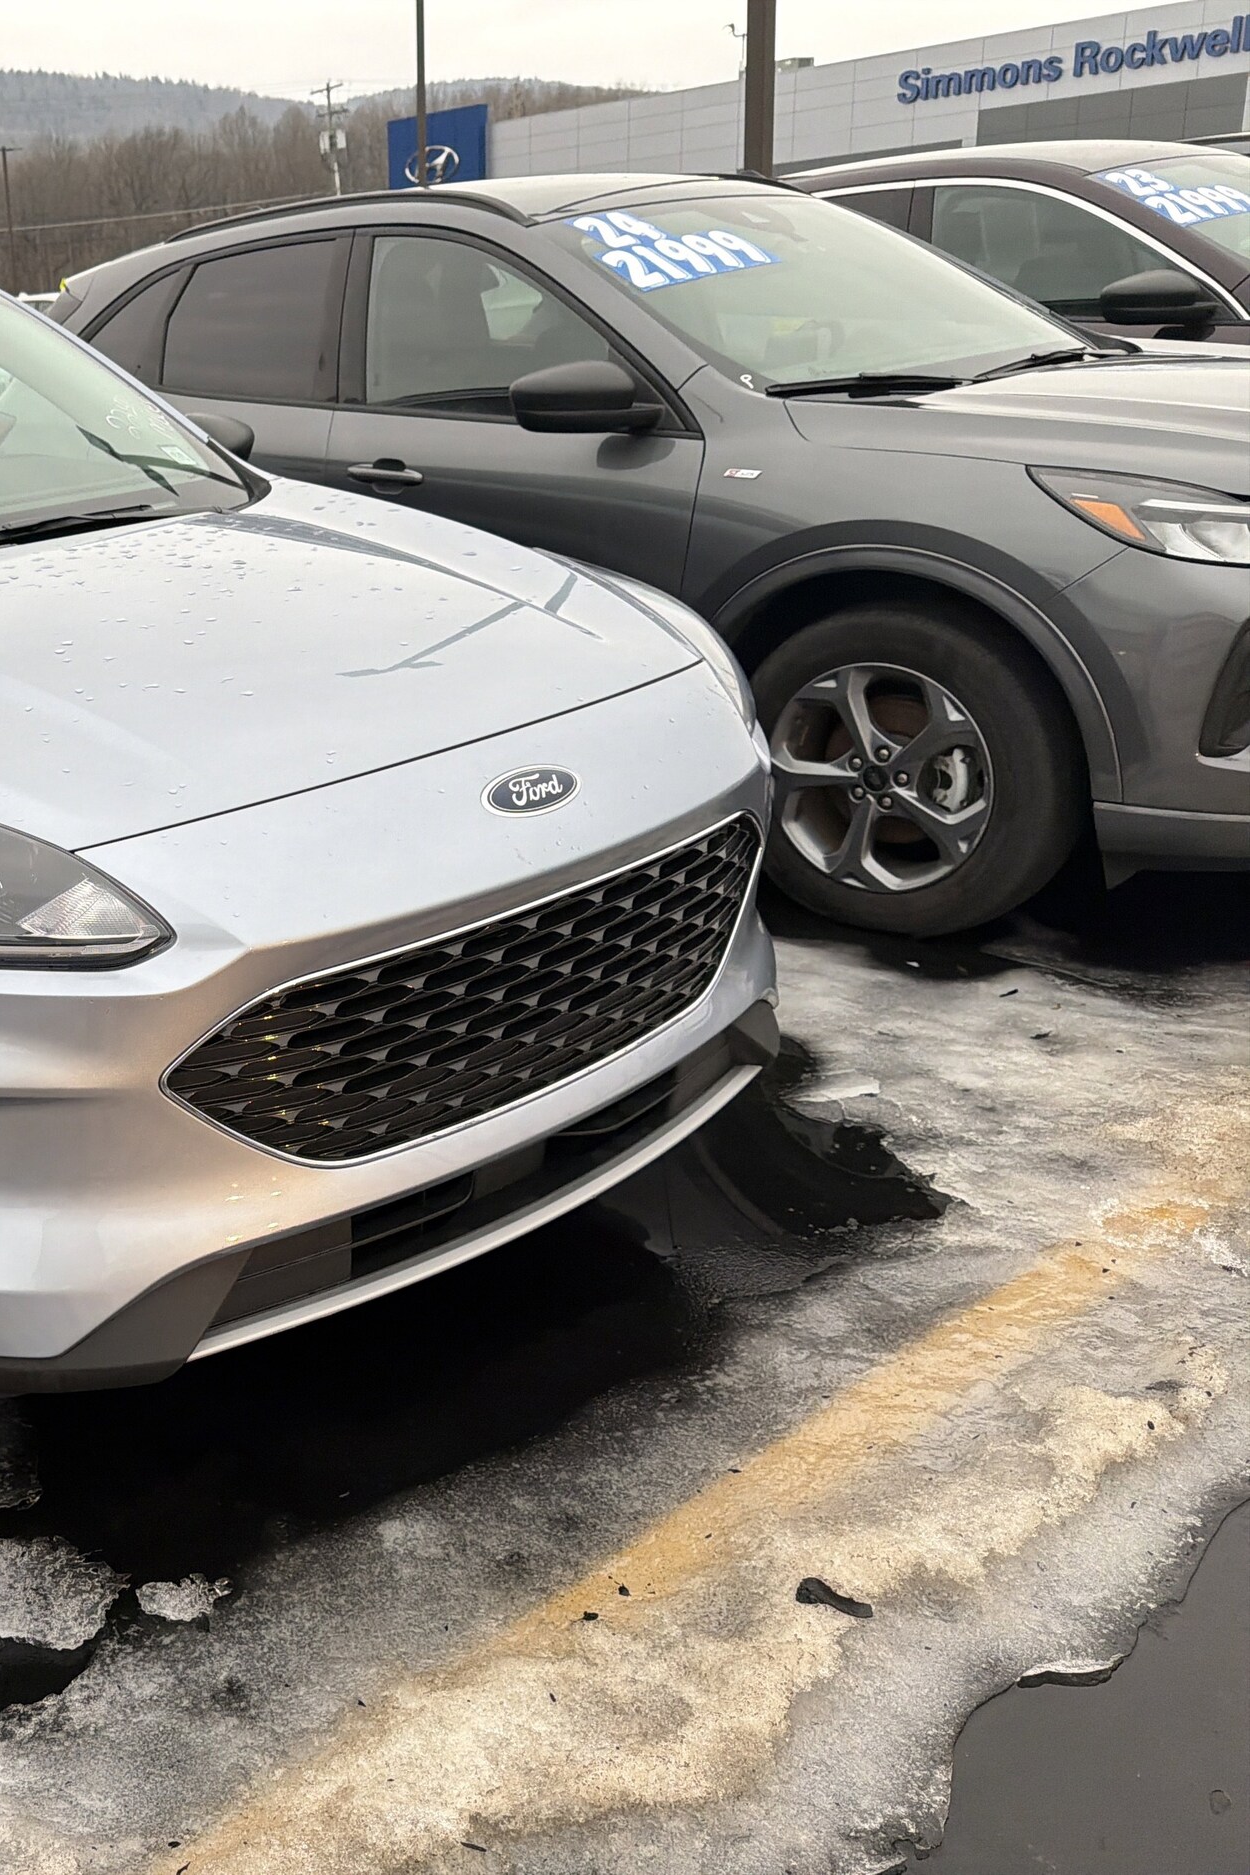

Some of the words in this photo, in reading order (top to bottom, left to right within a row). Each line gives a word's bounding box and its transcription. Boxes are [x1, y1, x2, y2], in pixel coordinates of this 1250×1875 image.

[897, 55, 1063, 104] Simmons
[1104, 168, 1175, 196] 23
[1144, 184, 1250, 224] 21999
[573, 211, 667, 248] 24
[601, 230, 772, 289] 21999
[508, 773, 563, 806] Ford
